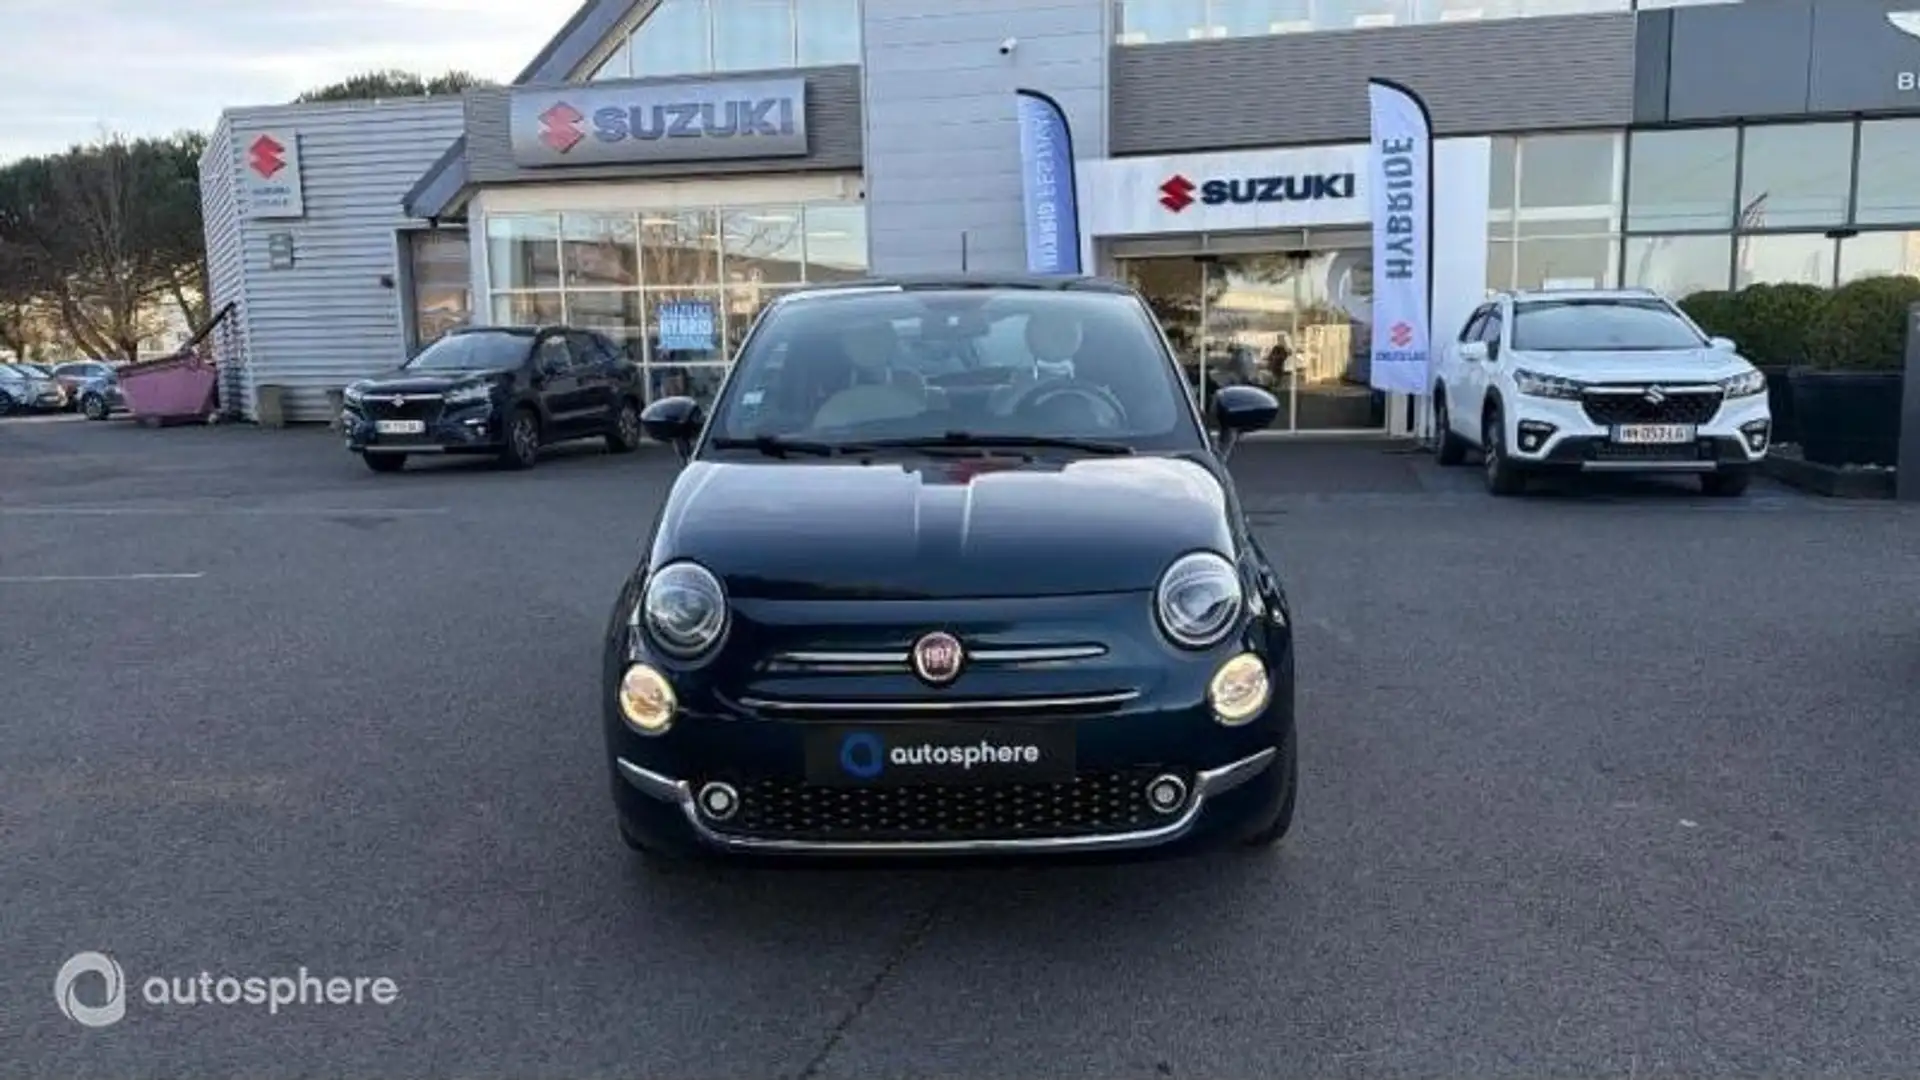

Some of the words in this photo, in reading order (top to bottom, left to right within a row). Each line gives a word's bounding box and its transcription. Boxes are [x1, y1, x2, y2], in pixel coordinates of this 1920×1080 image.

[1898, 72, 1920, 90] B
[593, 97, 794, 143] SUZUKI
[1201, 173, 1355, 205] SUZUKI
